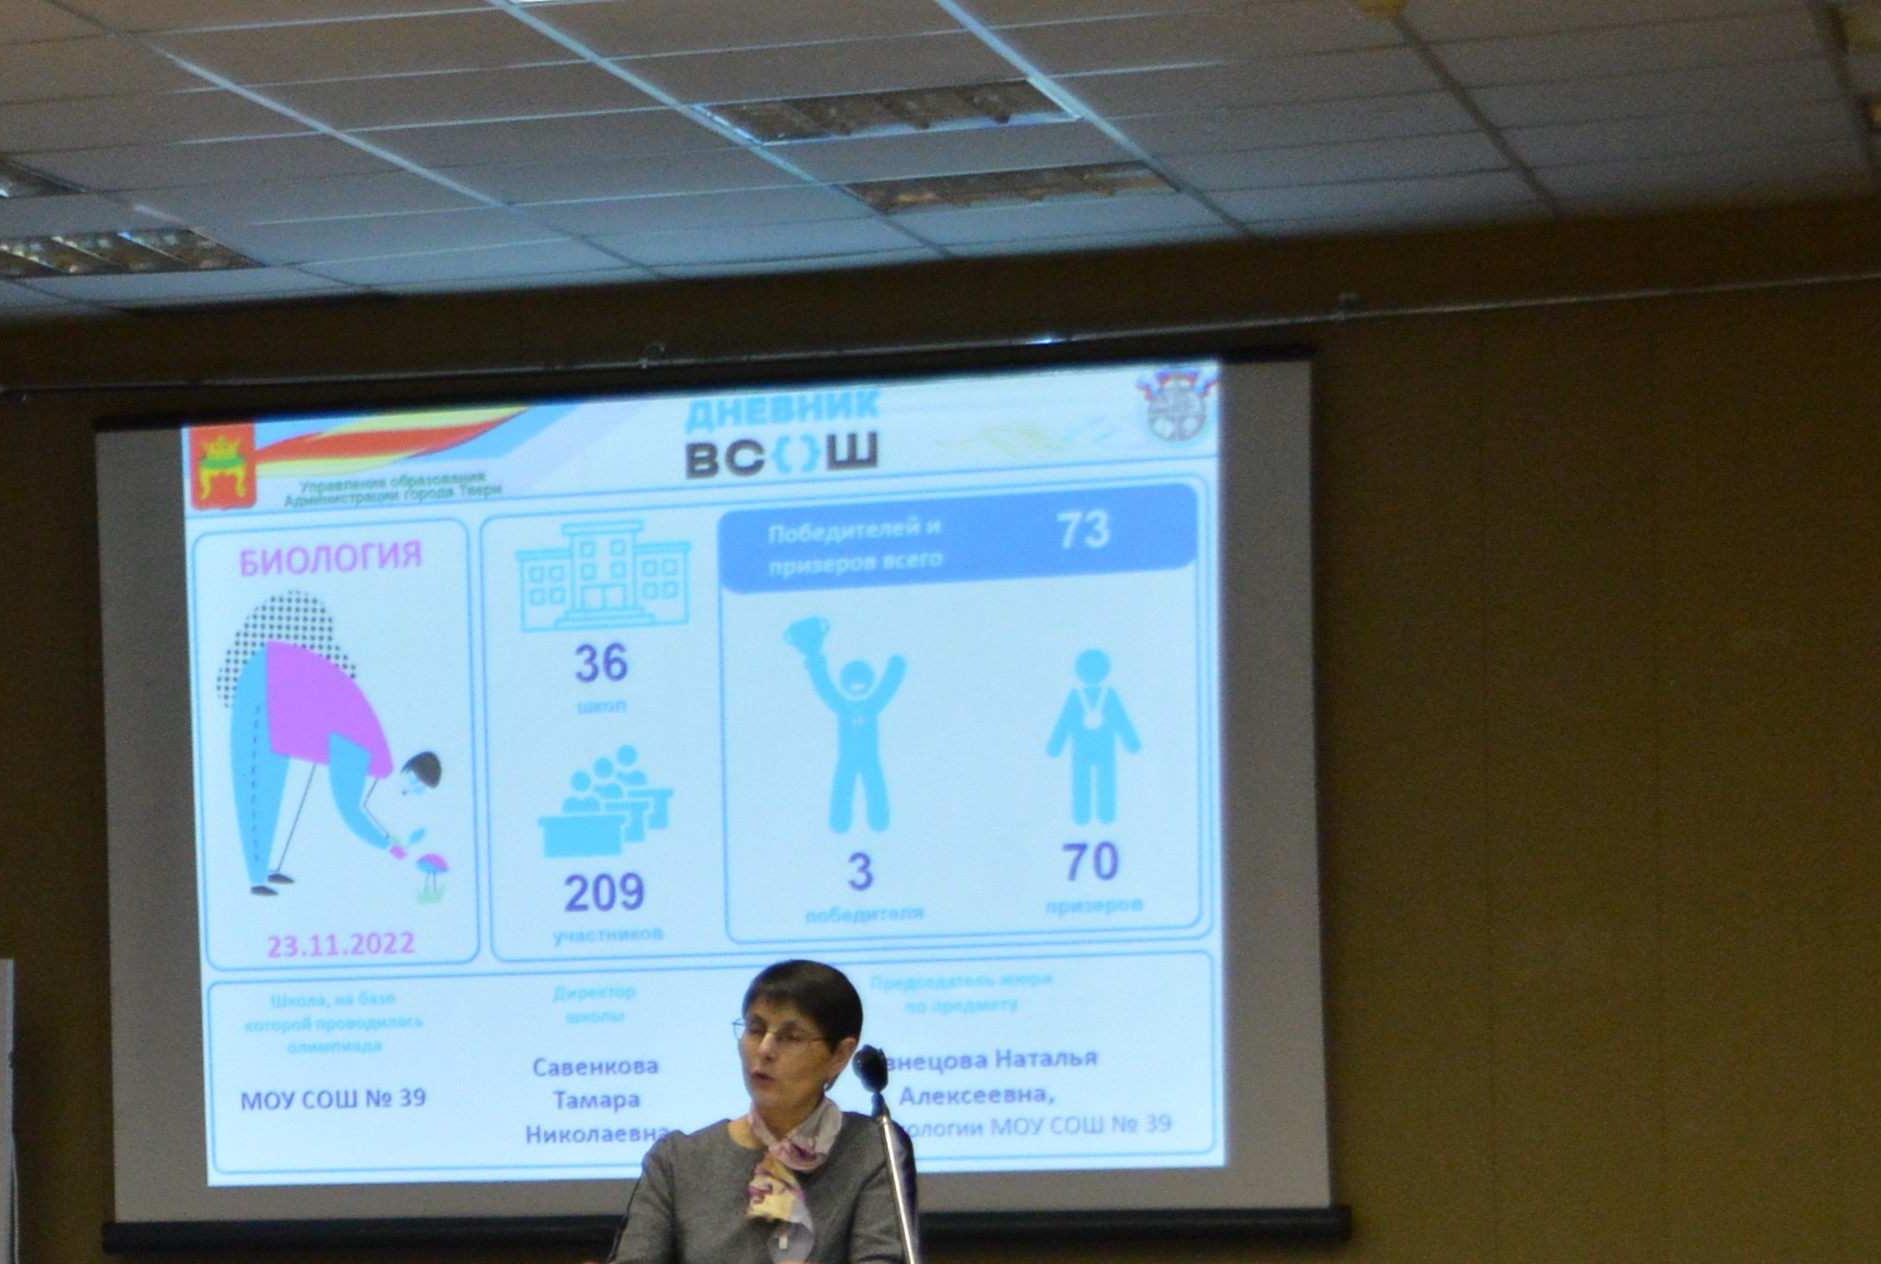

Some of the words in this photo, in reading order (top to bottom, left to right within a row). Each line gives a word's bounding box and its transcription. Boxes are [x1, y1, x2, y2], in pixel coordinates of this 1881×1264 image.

[685, 389, 880, 434] ДНЕВНИК
[300, 478, 387, 496] Управление
[390, 472, 486, 489] образования
[460, 484, 503, 499] Твери
[768, 517, 919, 546] Победителей
[926, 518, 942, 535] и
[1057, 509, 1111, 550] 73
[239, 540, 422, 578] БИОЛОГИЯ
[768, 553, 876, 580] призеров
[882, 549, 945, 572] всего
[575, 642, 629, 684] 36
[848, 852, 874, 891] 3
[1062, 841, 1119, 881] 70
[564, 872, 645, 912] 209
[267, 931, 416, 959] 23.11.2022
[553, 925, 664, 948] участников
[316, 1015, 425, 1033] проводилась
[532, 1057, 659, 1077] Савенкова
[886, 1052, 988, 1074] знецова
[995, 1048, 1098, 1069] Наталья
[240, 1090, 295, 1110] МОУ
[302, 1090, 358, 1109] СОШ
[366, 1089, 392, 1108] №
[399, 1087, 426, 1107] 39
[553, 1090, 641, 1113] Тамара
[899, 1085, 1056, 1106] Алексеевна,
[905, 1122, 983, 1138] ологии
[991, 1116, 1044, 1137] МОУ
[1050, 1115, 1103, 1135] СОШ
[1111, 1114, 1138, 1133] №
[1145, 1113, 1172, 1133] 39
